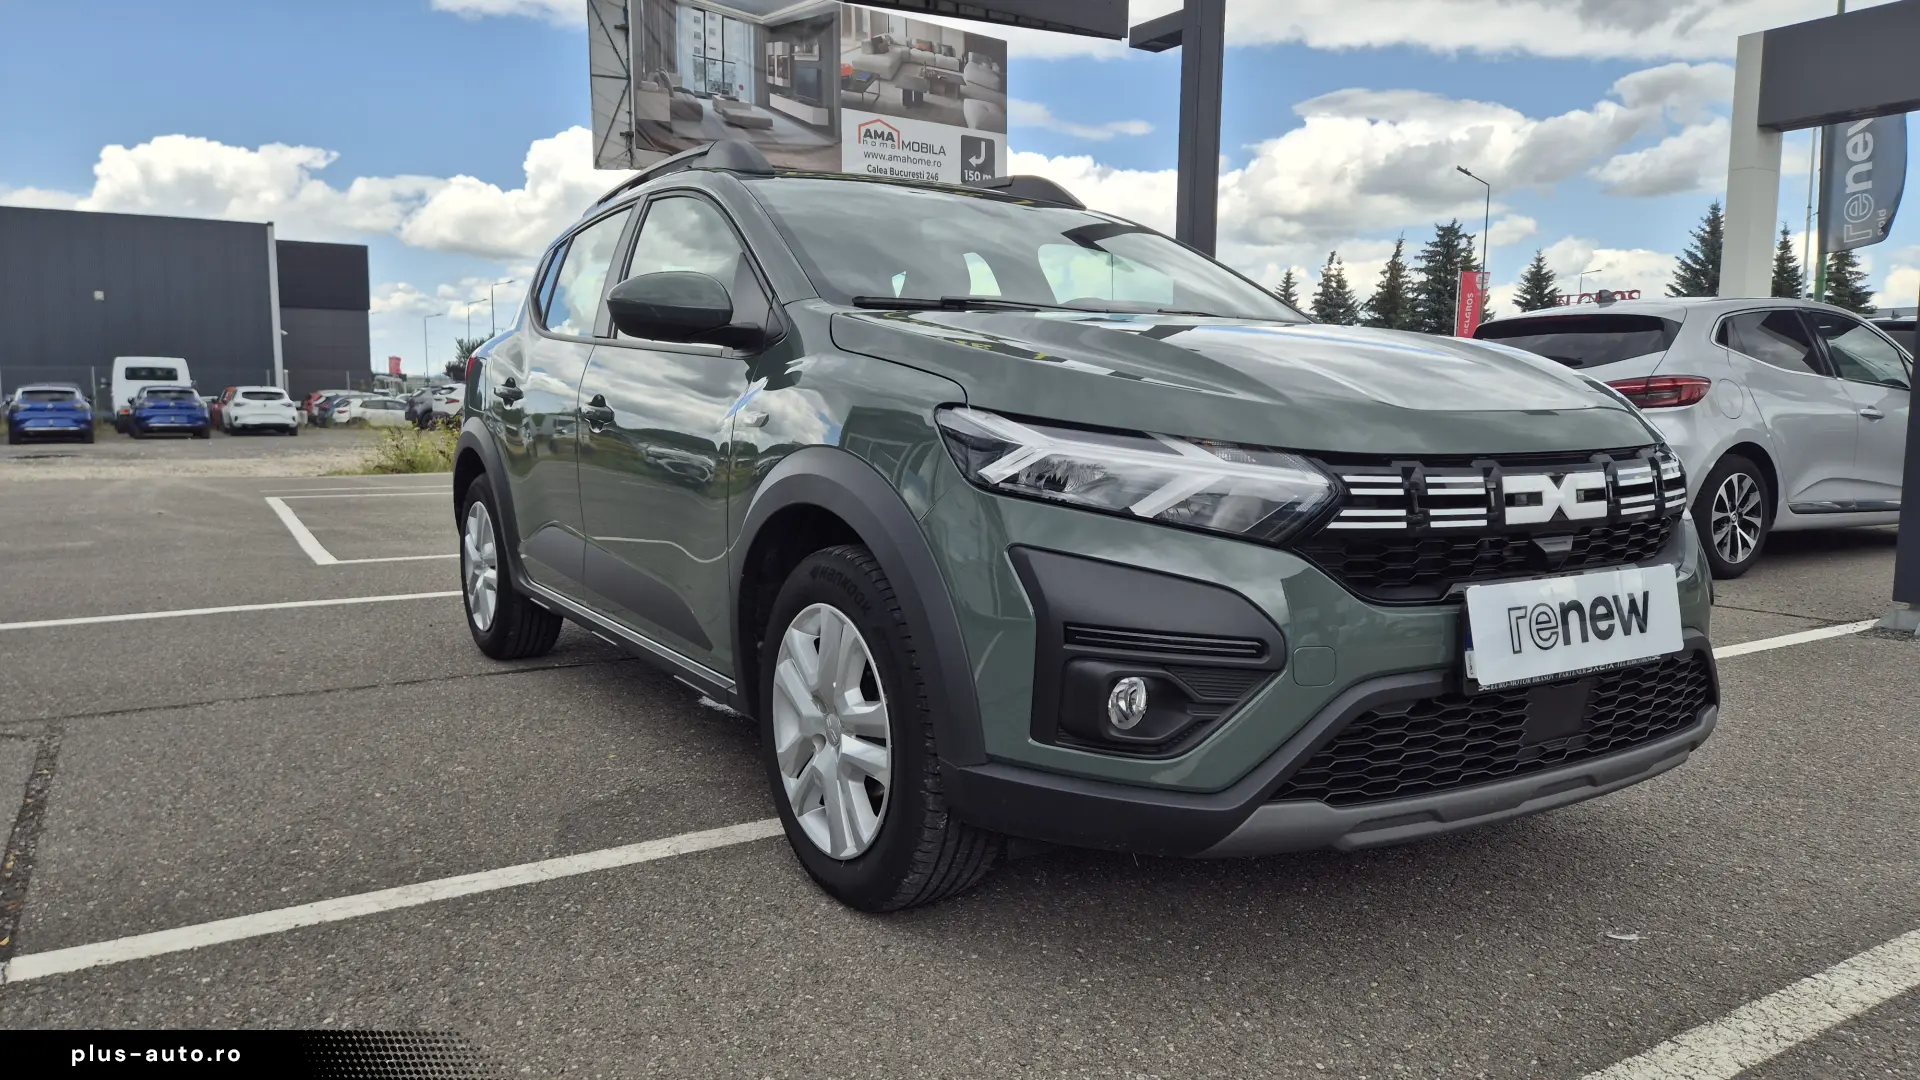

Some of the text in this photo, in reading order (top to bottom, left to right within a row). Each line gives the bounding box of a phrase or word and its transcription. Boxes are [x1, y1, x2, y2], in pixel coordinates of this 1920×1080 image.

[863, 128, 895, 142] AMA
[863, 139, 896, 149] home
[902, 140, 946, 156] MOBILA
[864, 151, 942, 168] www.amahome.ro
[867, 164, 888, 175] Calea
[926, 172, 939, 182] 246
[964, 170, 981, 181] 150
[1844, 118, 1875, 243] rene
[1506, 590, 1650, 655] renew
